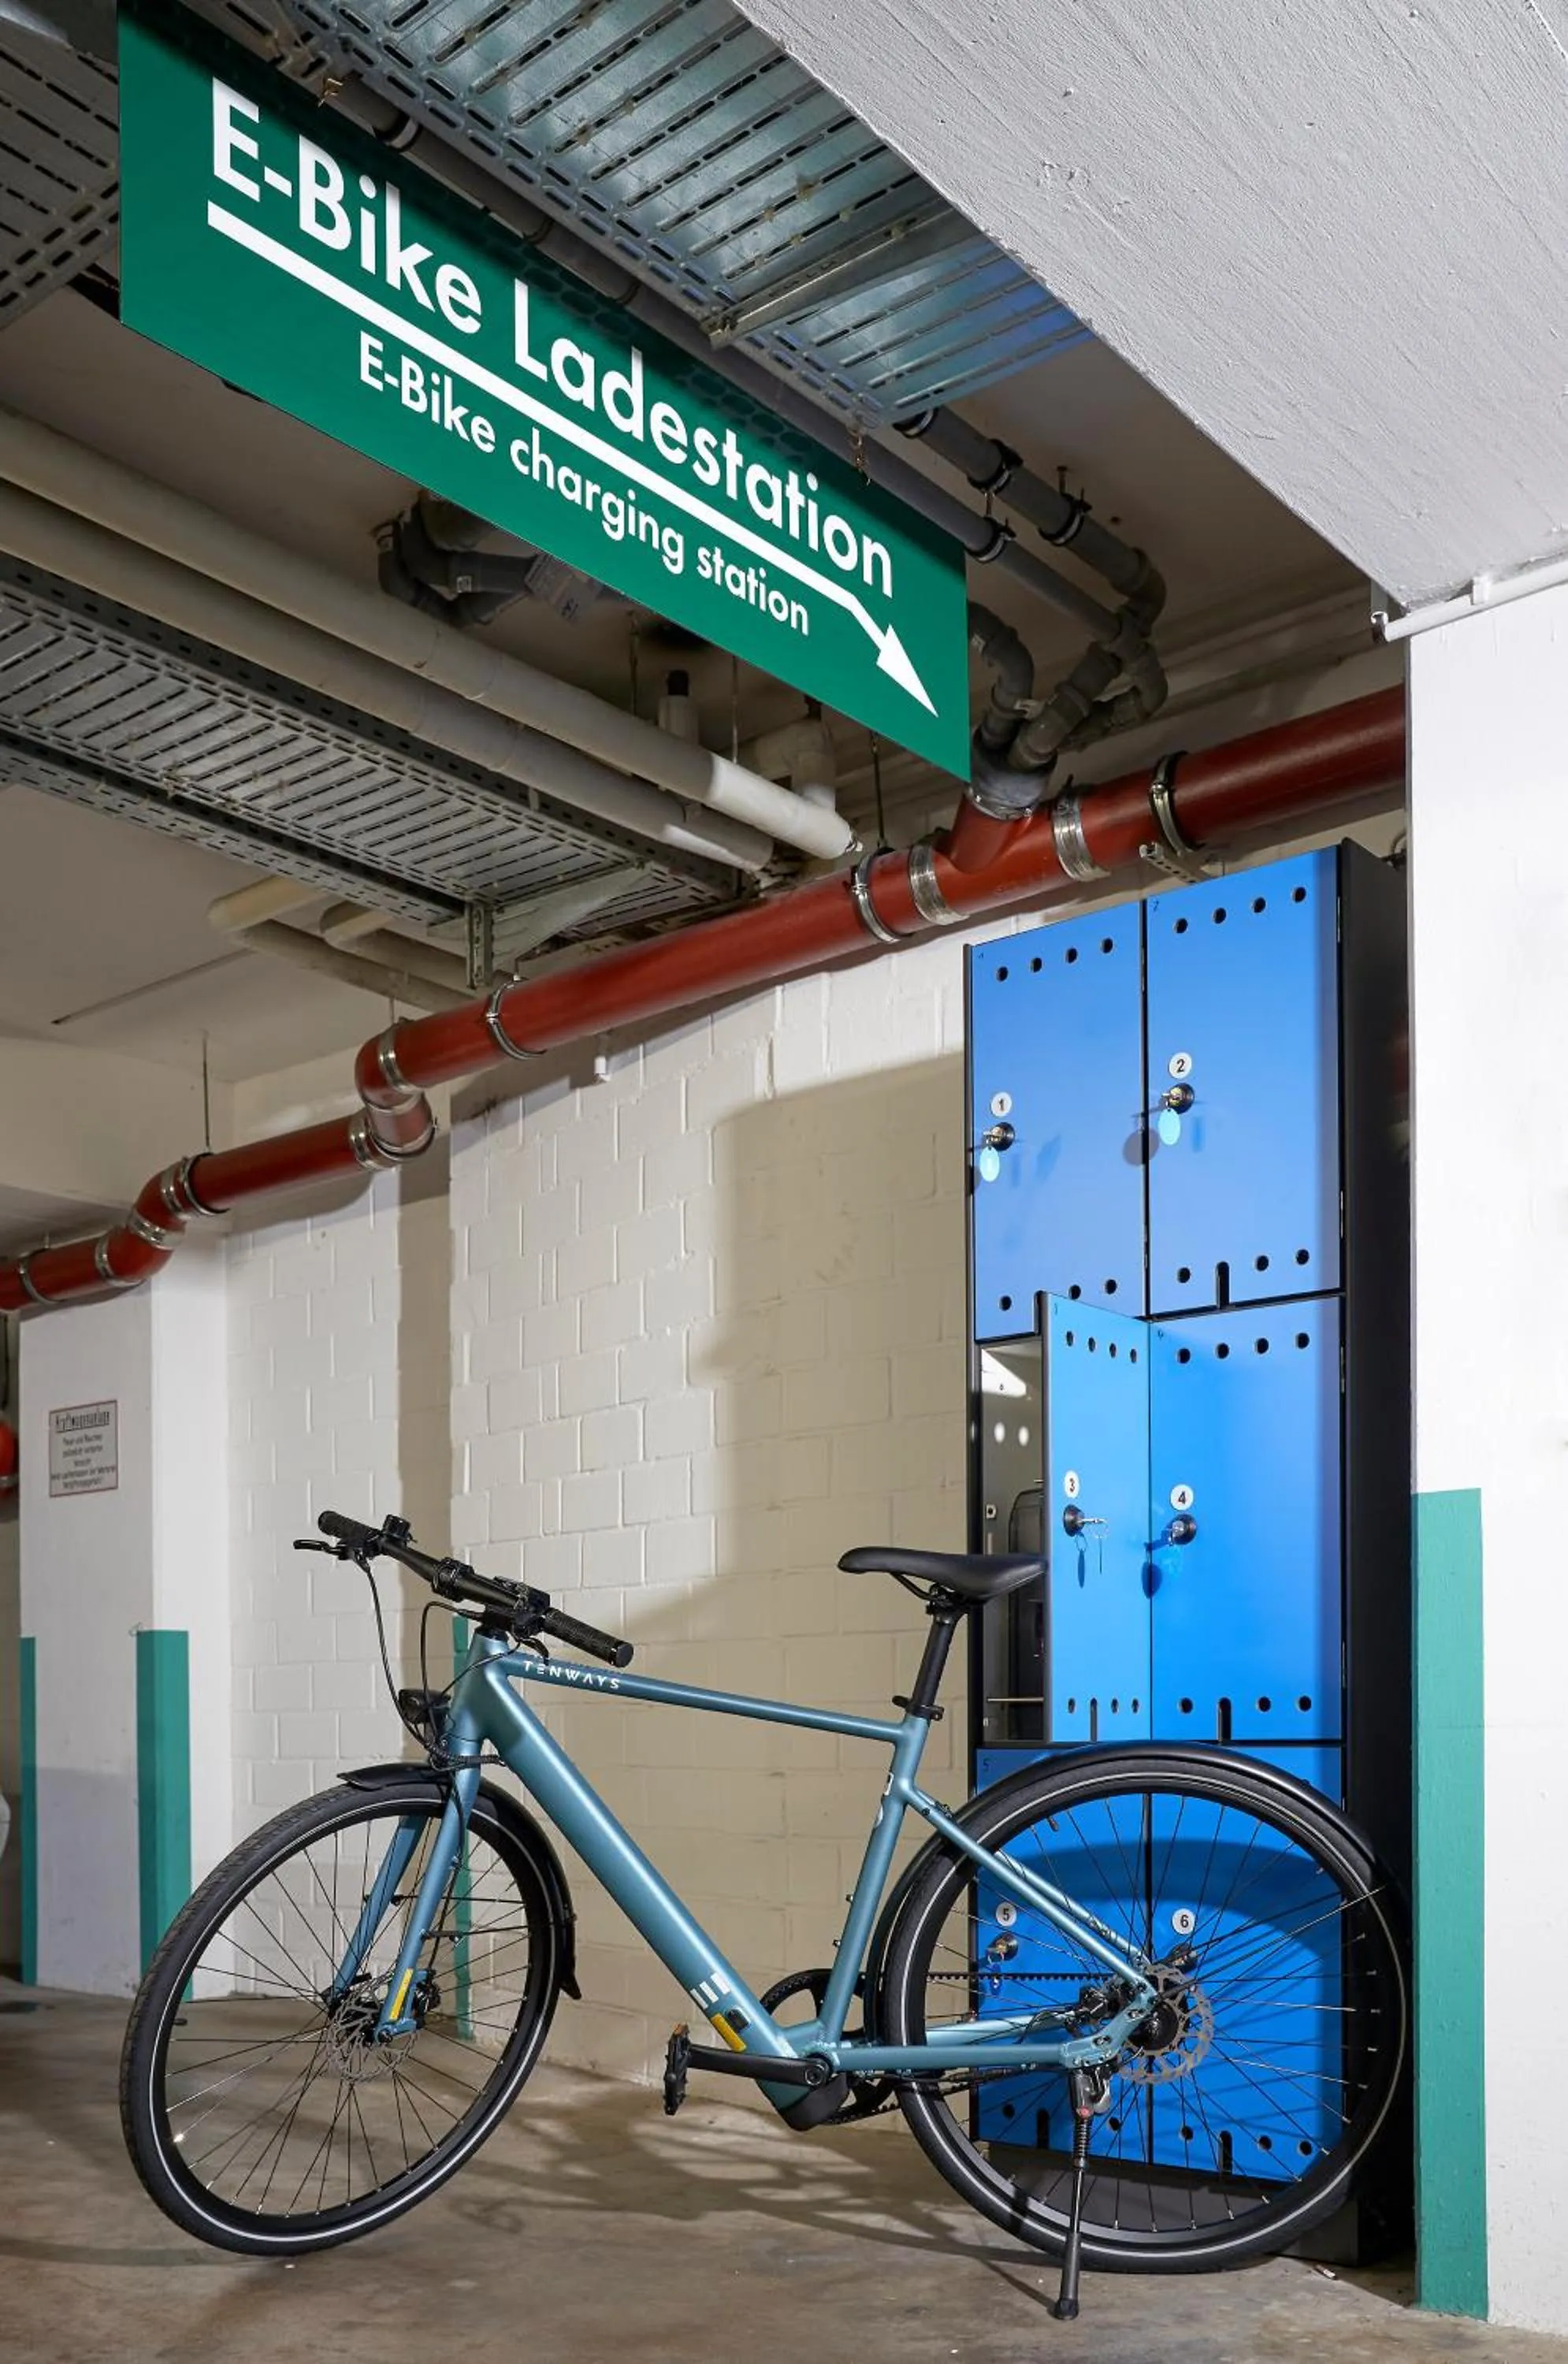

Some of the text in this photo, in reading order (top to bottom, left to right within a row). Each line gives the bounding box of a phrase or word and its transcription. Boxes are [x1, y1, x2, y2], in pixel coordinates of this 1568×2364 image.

[212, 78, 893, 597] E-Bike Ladestation
[360, 331, 808, 635] E-Bike charging station
[1176, 1058, 1185, 1073] 2
[998, 1098, 1005, 1112] 1
[1069, 1478, 1076, 1493] 3
[1178, 1490, 1187, 1505] 4
[522, 1660, 621, 1690] TENWAYS
[1003, 1908, 1011, 1921] 5
[1180, 1914, 1189, 1928] 6
